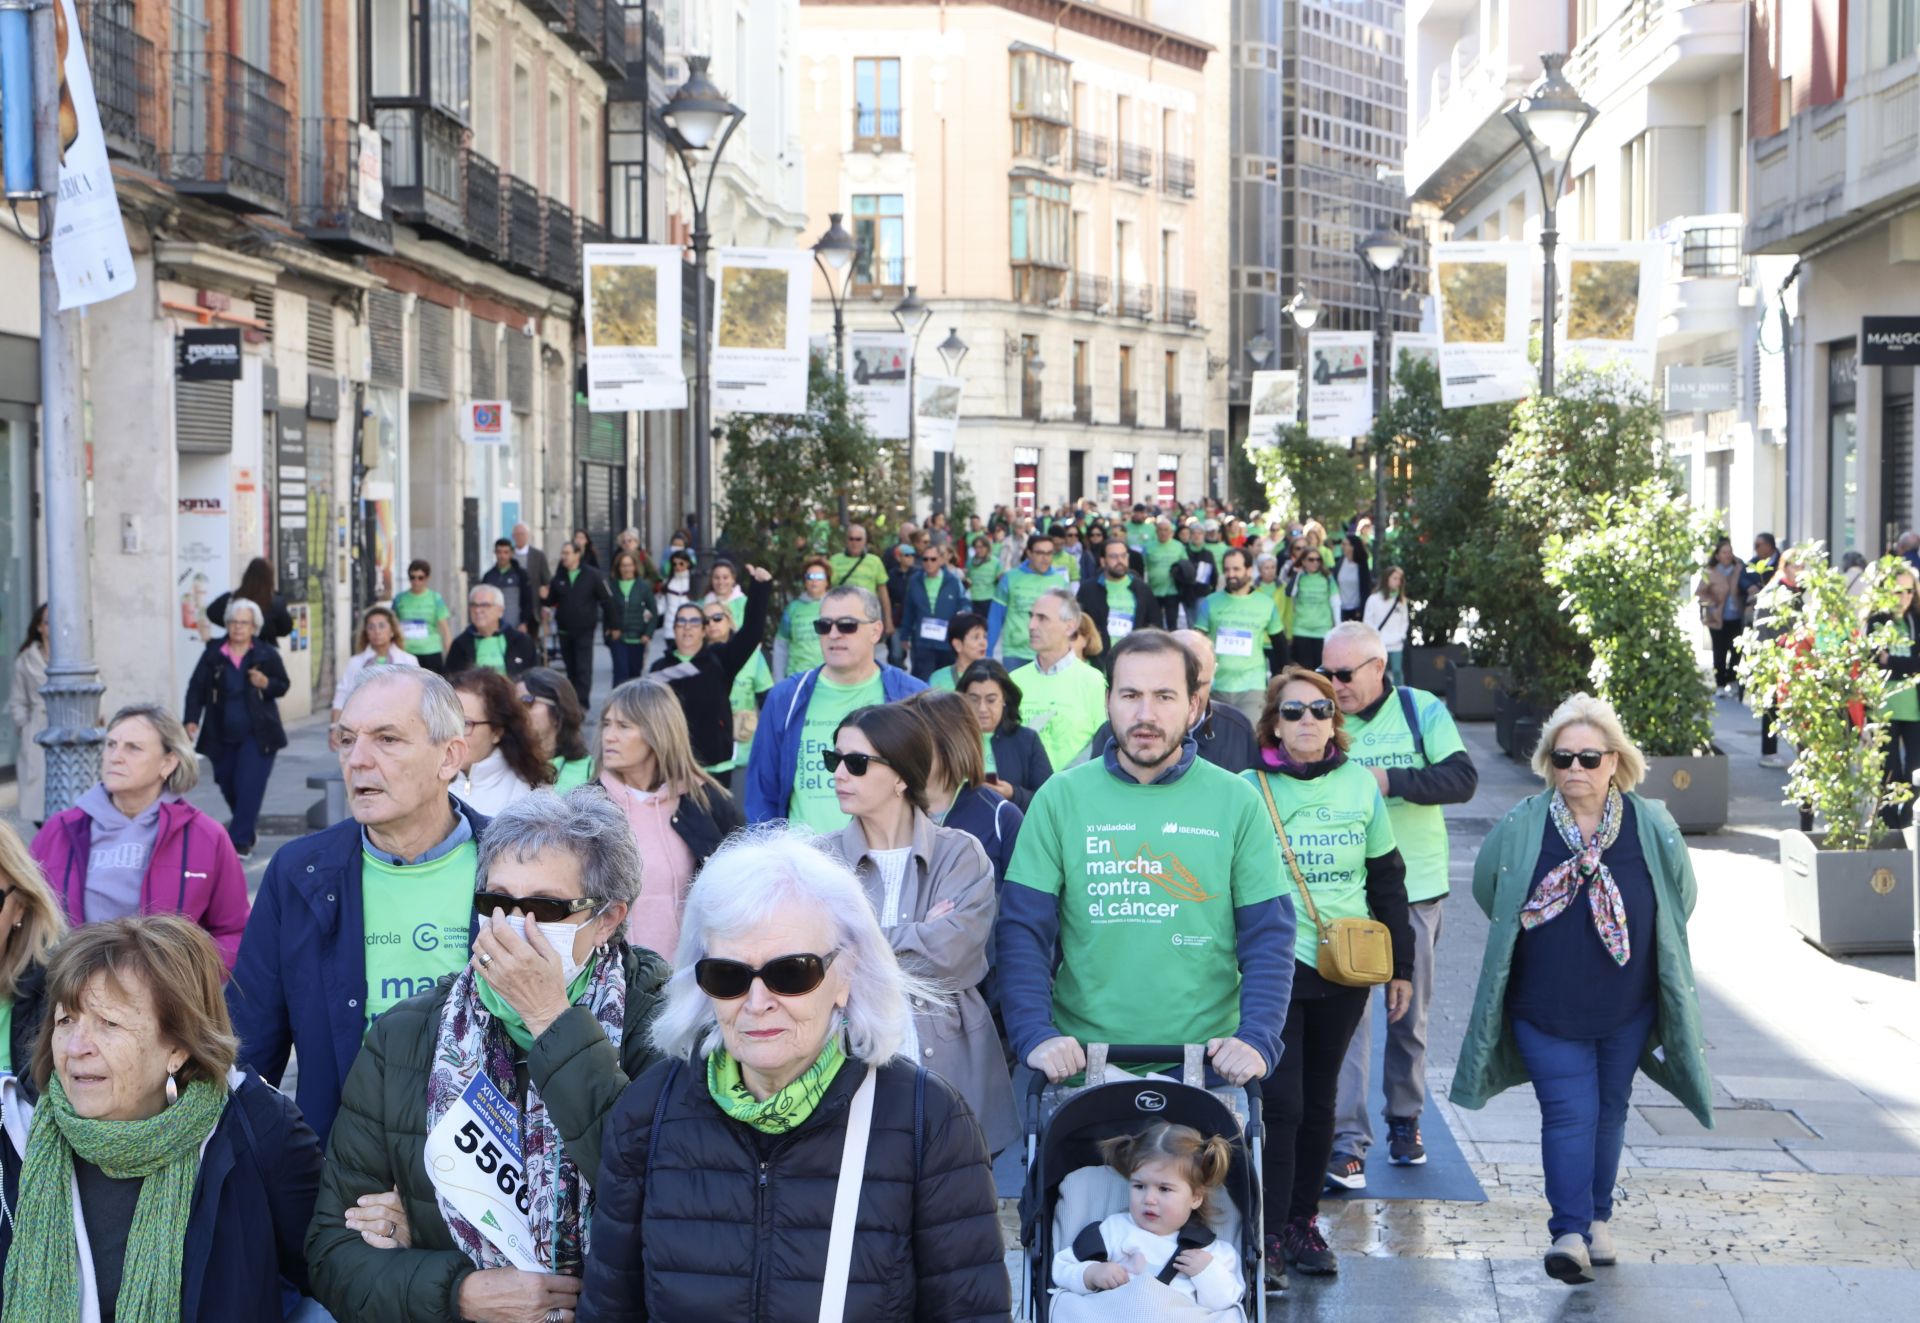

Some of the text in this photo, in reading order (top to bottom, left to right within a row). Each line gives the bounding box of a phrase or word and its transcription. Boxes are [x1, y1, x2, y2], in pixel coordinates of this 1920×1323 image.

[178, 498, 220, 511] egma
[806, 760, 826, 772] co
[1086, 823, 1136, 833] XI Valladolid
[1178, 826, 1220, 838] IBERDROLA
[1086, 836, 1111, 854] En
[1086, 856, 1163, 875] marcha
[1087, 878, 1151, 896] contra
[1088, 898, 1179, 917] el cáncer
[364, 931, 401, 945] drola
[381, 976, 436, 999] ma
[480, 1082, 497, 1101] XIV
[472, 1099, 496, 1127] contra
[494, 1124, 504, 1136] el
[476, 1091, 513, 1134] en marcha
